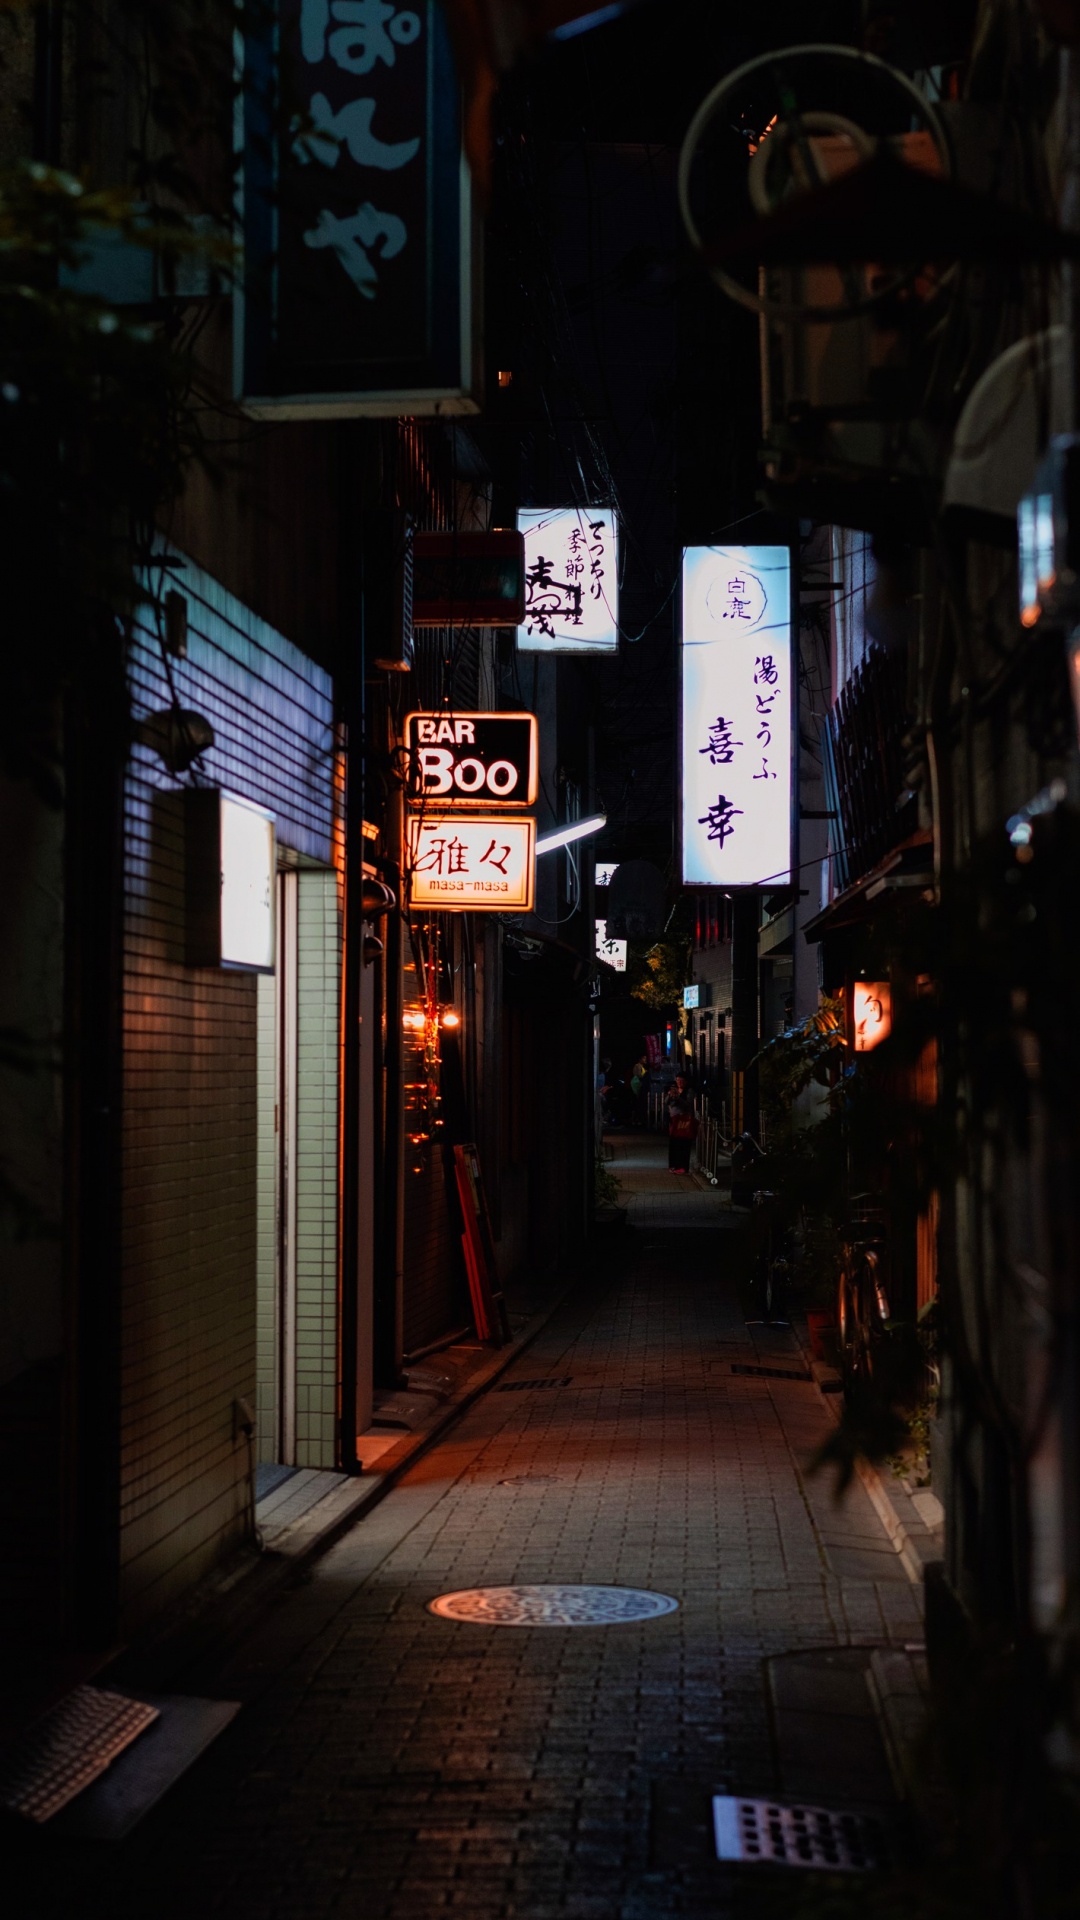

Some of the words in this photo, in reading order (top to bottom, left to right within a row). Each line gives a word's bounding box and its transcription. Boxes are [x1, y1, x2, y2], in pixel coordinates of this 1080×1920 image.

[723, 577, 751, 619] 白鹿
[417, 720, 475, 743] BAR
[753, 655, 781, 780] 湯どうふ
[698, 716, 744, 850] 喜幸
[428, 836, 512, 875] 雅々
[429, 879, 509, 892] masa-masa
